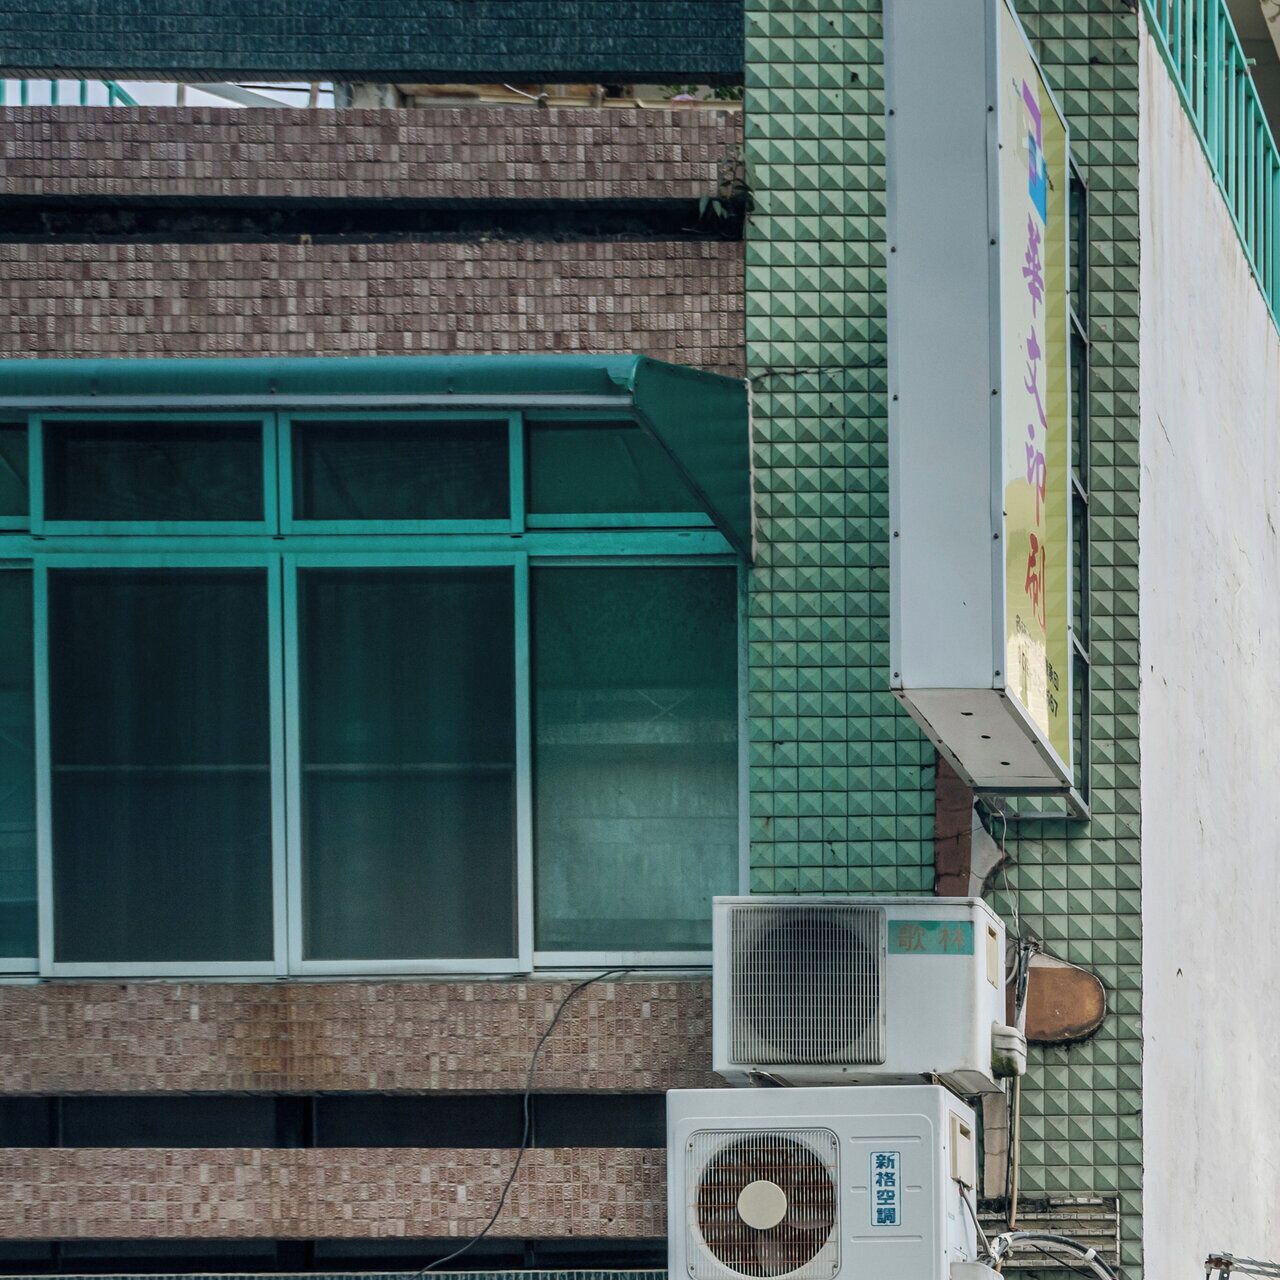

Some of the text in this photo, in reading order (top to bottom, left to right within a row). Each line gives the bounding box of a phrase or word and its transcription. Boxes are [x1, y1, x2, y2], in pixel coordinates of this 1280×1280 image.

[897, 922, 965, 951] 歌林
[874, 1152, 897, 1225] 新格空調
